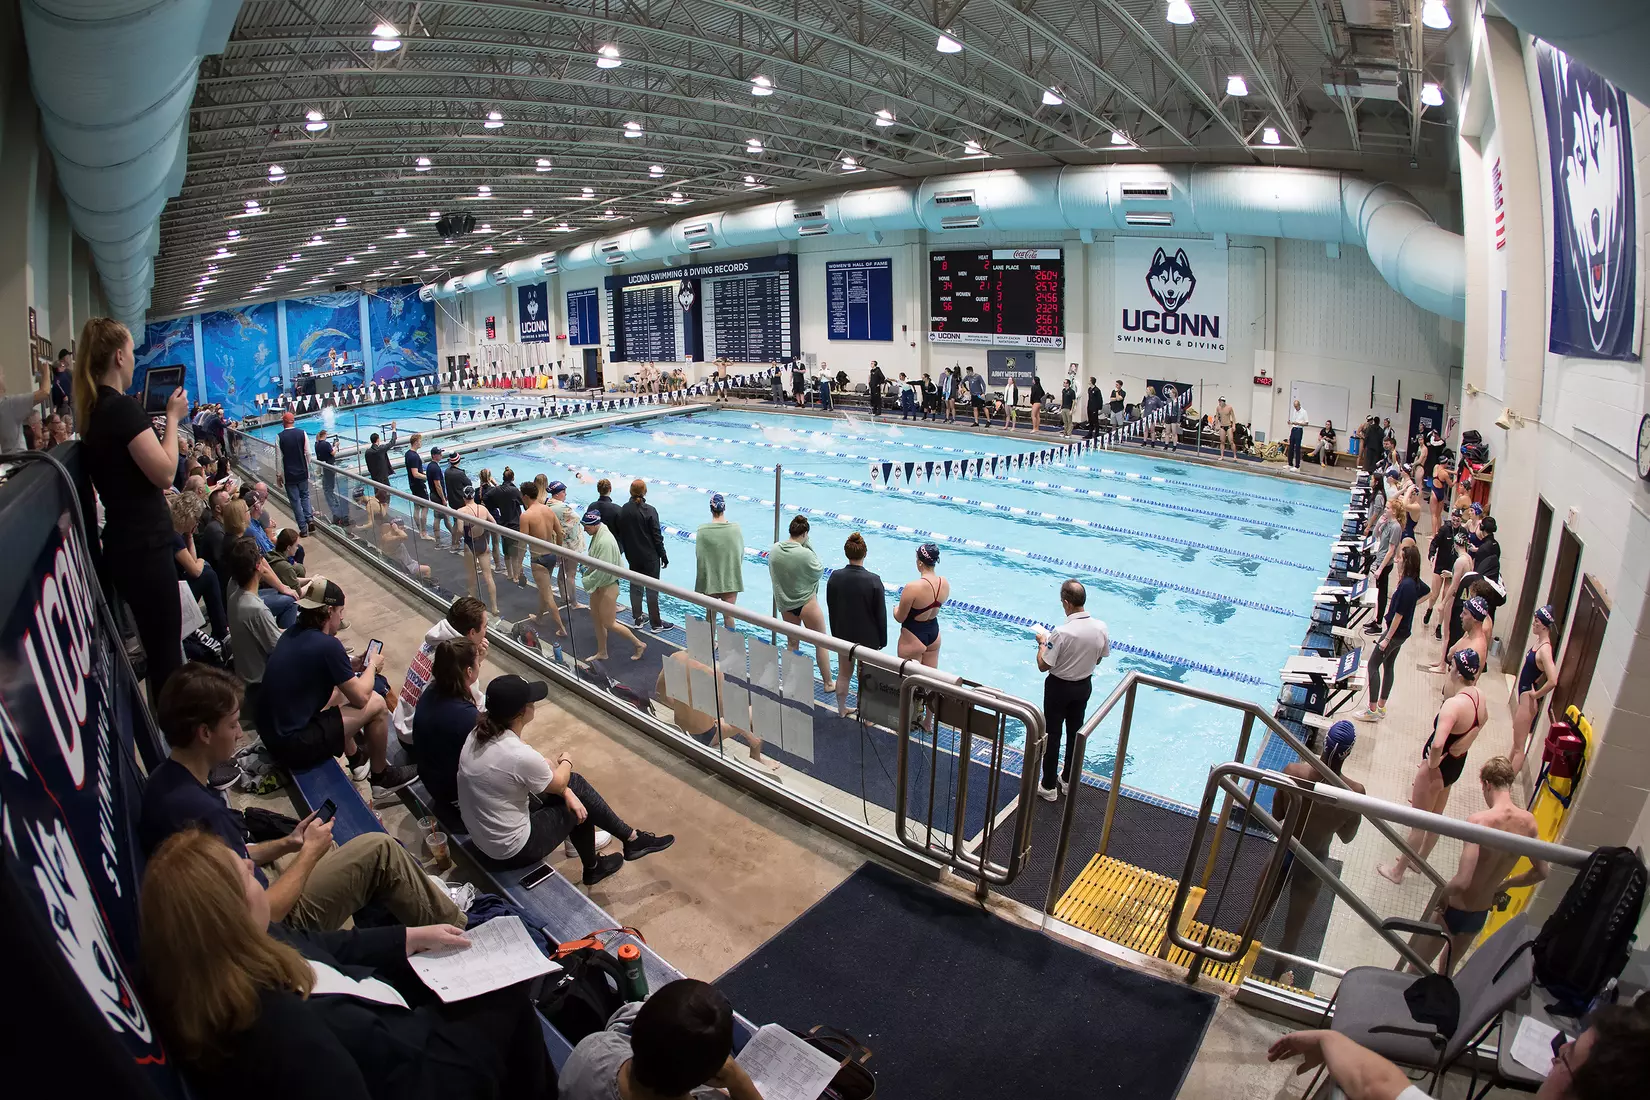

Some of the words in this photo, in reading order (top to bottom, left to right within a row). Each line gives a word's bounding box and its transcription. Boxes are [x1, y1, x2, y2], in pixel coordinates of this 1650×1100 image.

[941, 261, 948, 270] 8
[983, 260, 990, 270] 2
[628, 274, 650, 284] UCONN
[651, 269, 683, 281] SWIMMING
[684, 269, 689, 277] &
[690, 266, 713, 276] DIVING
[714, 262, 749, 274] RECORDS
[943, 281, 953, 291] 34
[980, 281, 990, 290] 21
[996, 281, 1003, 291] 2
[997, 291, 1003, 301] 3
[943, 302, 953, 311] 56
[997, 303, 1003, 311] 4
[997, 313, 1003, 323] 5
[1122, 308, 1220, 338] UCONN
[521, 320, 548, 334] UCONN
[997, 323, 1003, 333] 6
[937, 332, 961, 340] UCONN
[1026, 336, 1052, 344] UCONN
[1117, 334, 1171, 346] SWIMMING
[1187, 341, 1225, 351] DIVING
[1335, 610, 1341, 621] 5
[1309, 693, 1317, 705] 6
